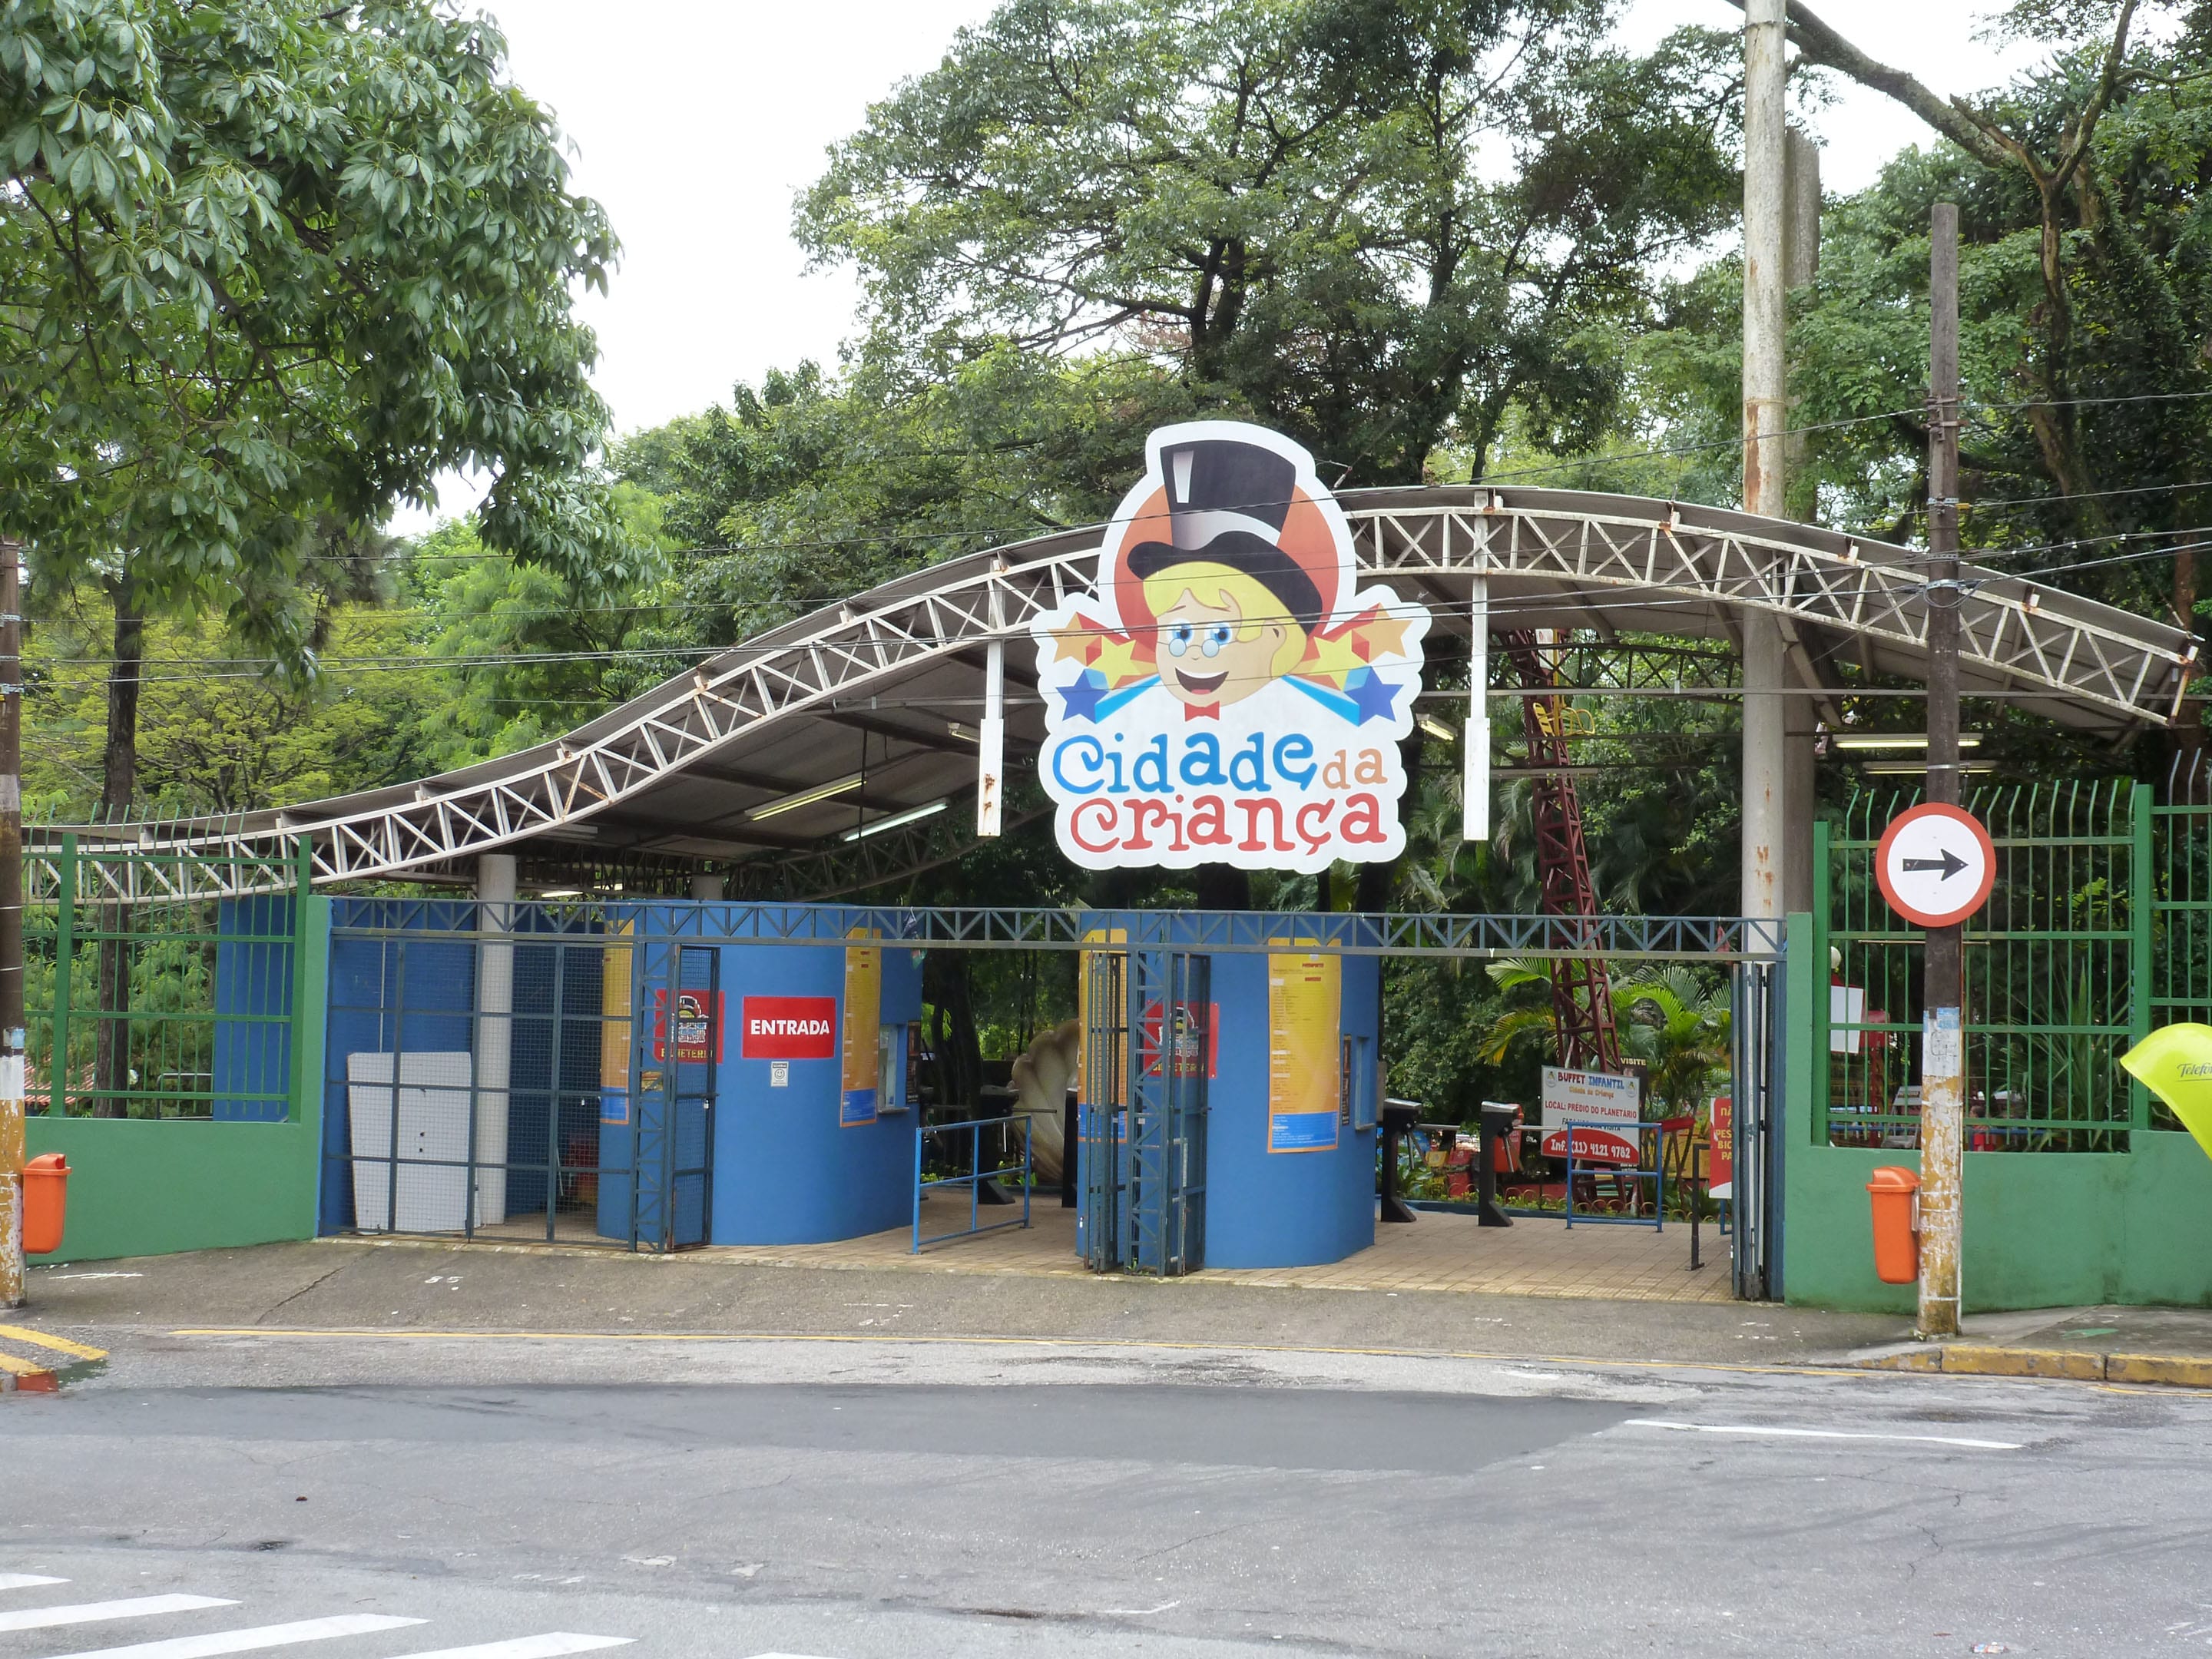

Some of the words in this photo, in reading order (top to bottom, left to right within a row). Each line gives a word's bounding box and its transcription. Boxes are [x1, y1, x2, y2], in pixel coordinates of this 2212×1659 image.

[1052, 732, 1317, 794] Cidade
[1323, 749, 1388, 790] da
[1070, 793, 1388, 856] Criança
[750, 1019, 830, 1035] ENTRADA
[1620, 1057, 1647, 1066] VISITE
[1558, 1071, 1586, 1084] BUFFET
[1588, 1075, 1625, 1090] INFANTIL
[1545, 1101, 1566, 1111] LOCAL:
[1591, 1106, 1599, 1114] DO
[1551, 1138, 1568, 1152] Inf.
[1571, 1141, 1588, 1154] (11)
[1590, 1143, 1609, 1157] 4121
[1611, 1145, 1631, 1159] 9782
